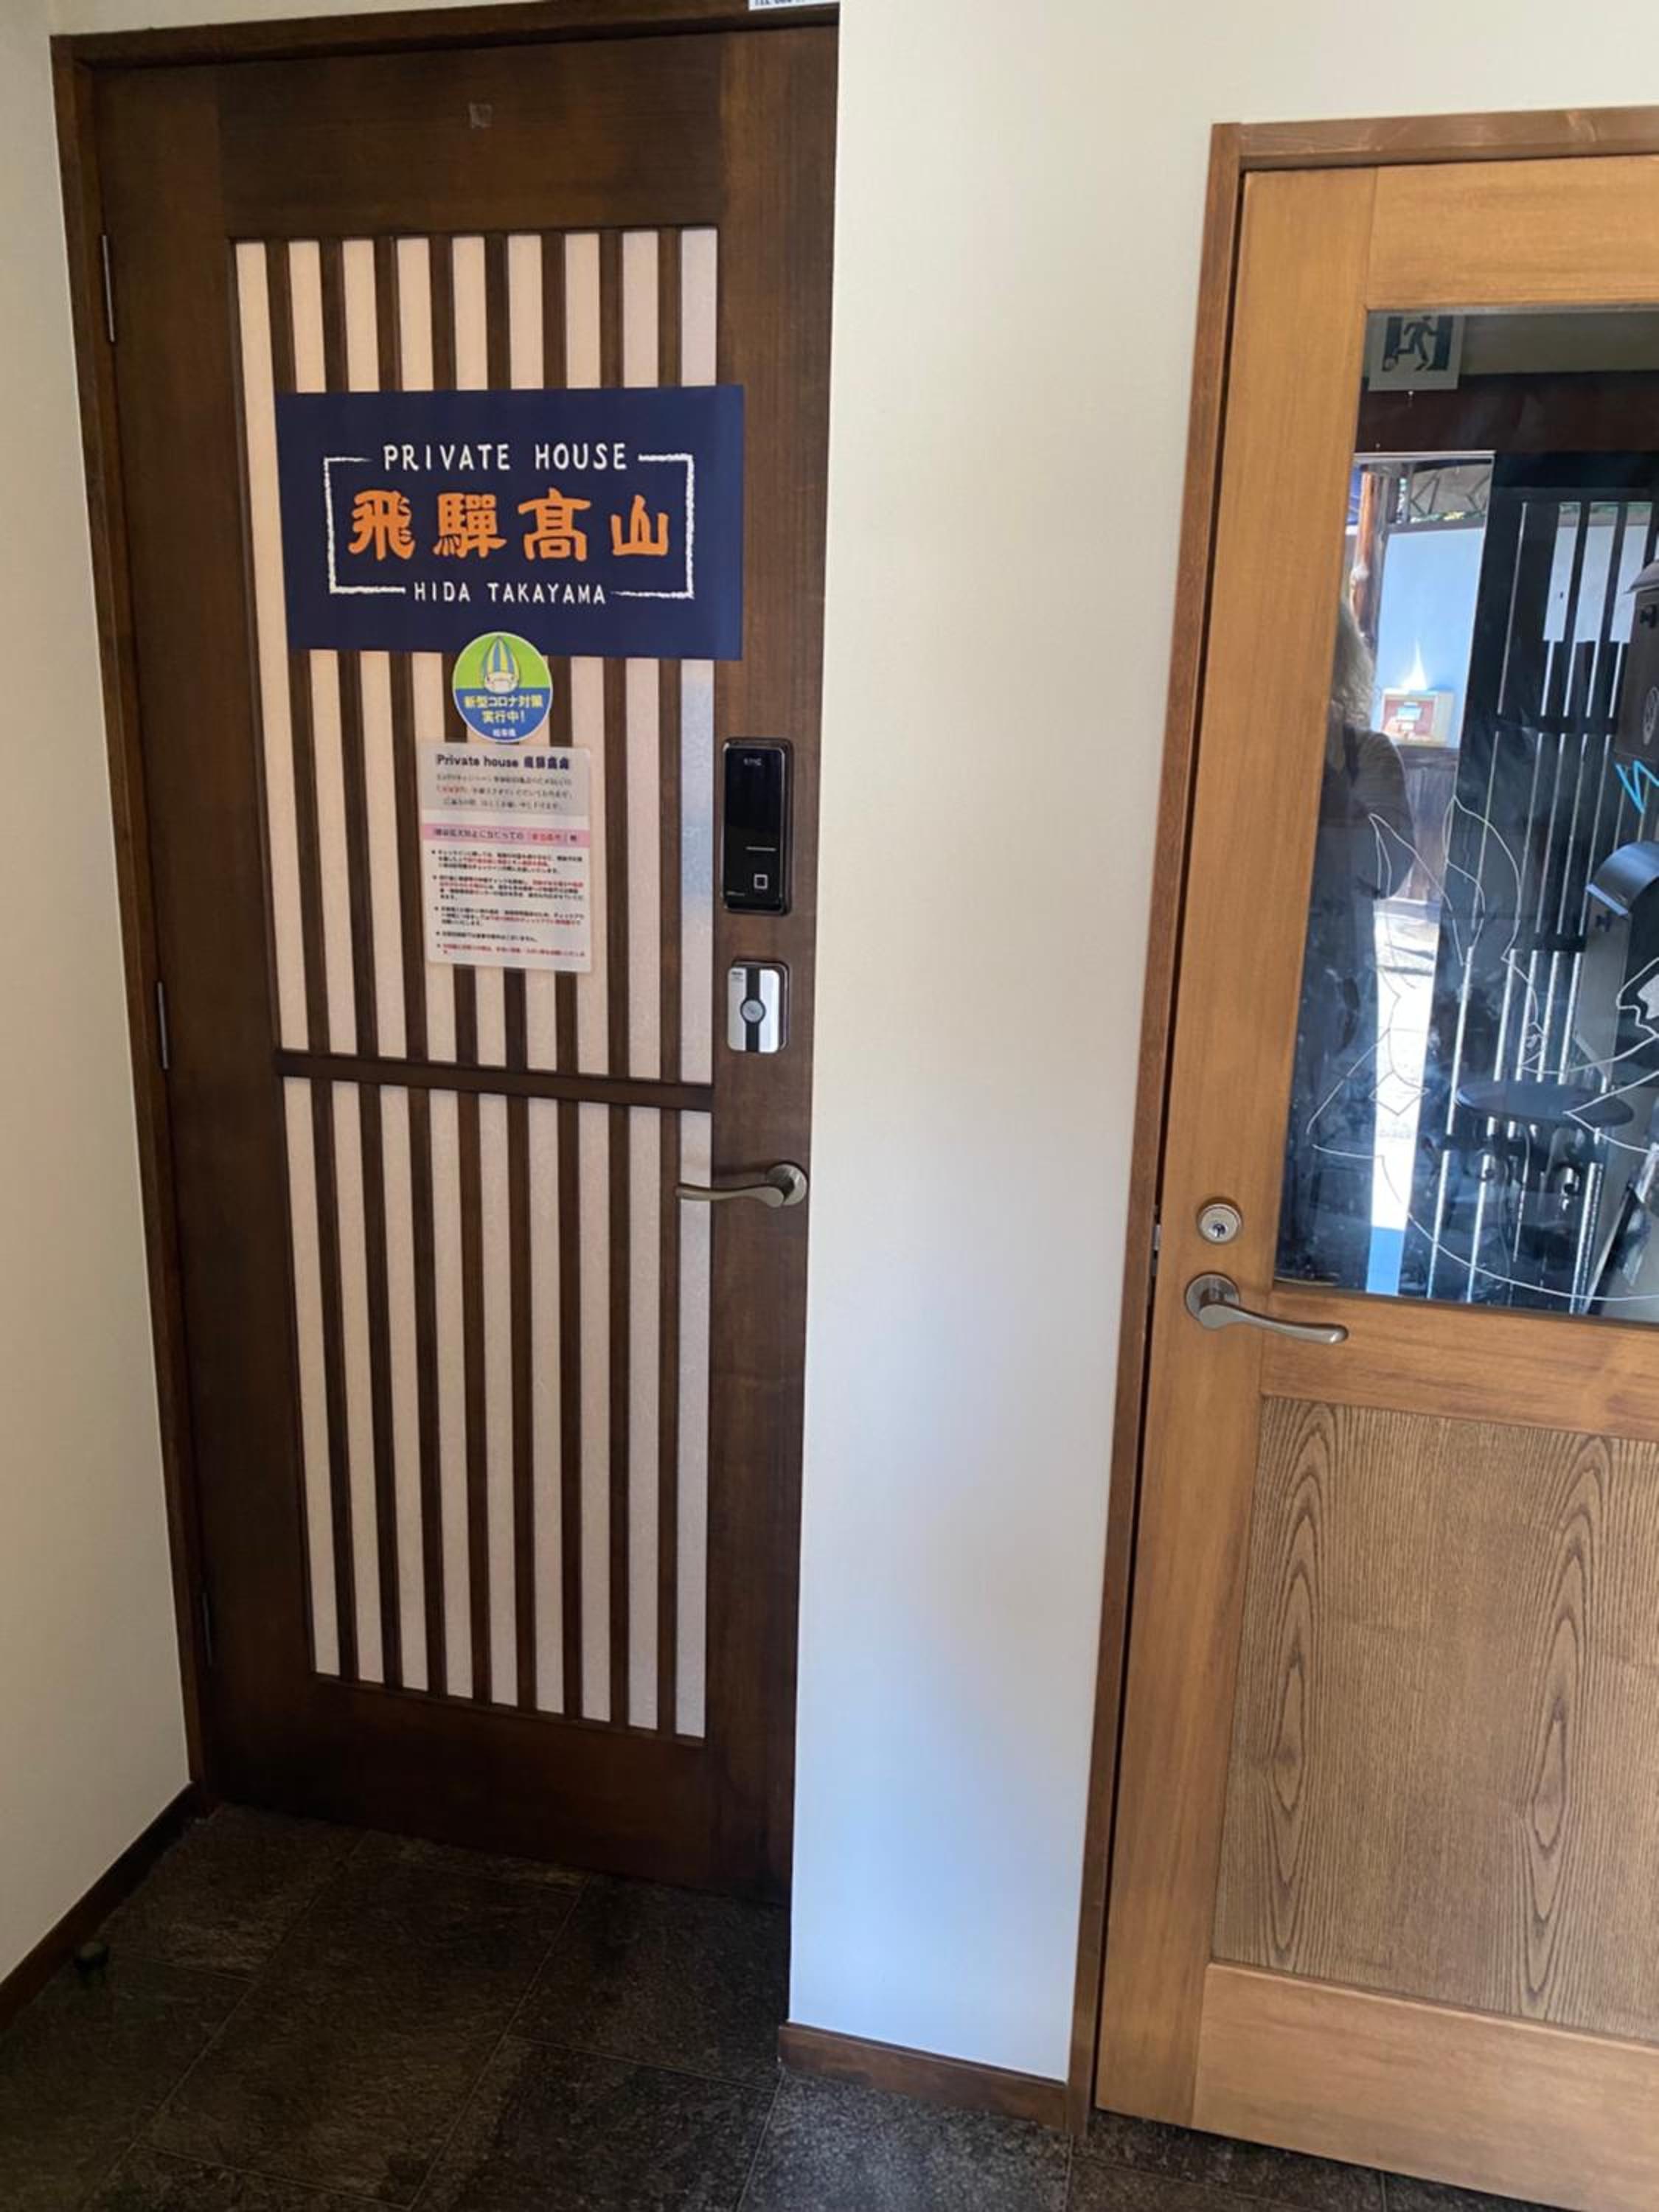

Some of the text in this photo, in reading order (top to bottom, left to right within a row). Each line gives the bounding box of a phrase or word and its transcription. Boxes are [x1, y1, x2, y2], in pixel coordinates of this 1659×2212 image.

[383, 442, 627, 471] PRIVATE HOUSE
[414, 582, 605, 605] HIDA TAKAYAMA
[437, 754, 480, 767] Private
[484, 757, 519, 768] house
